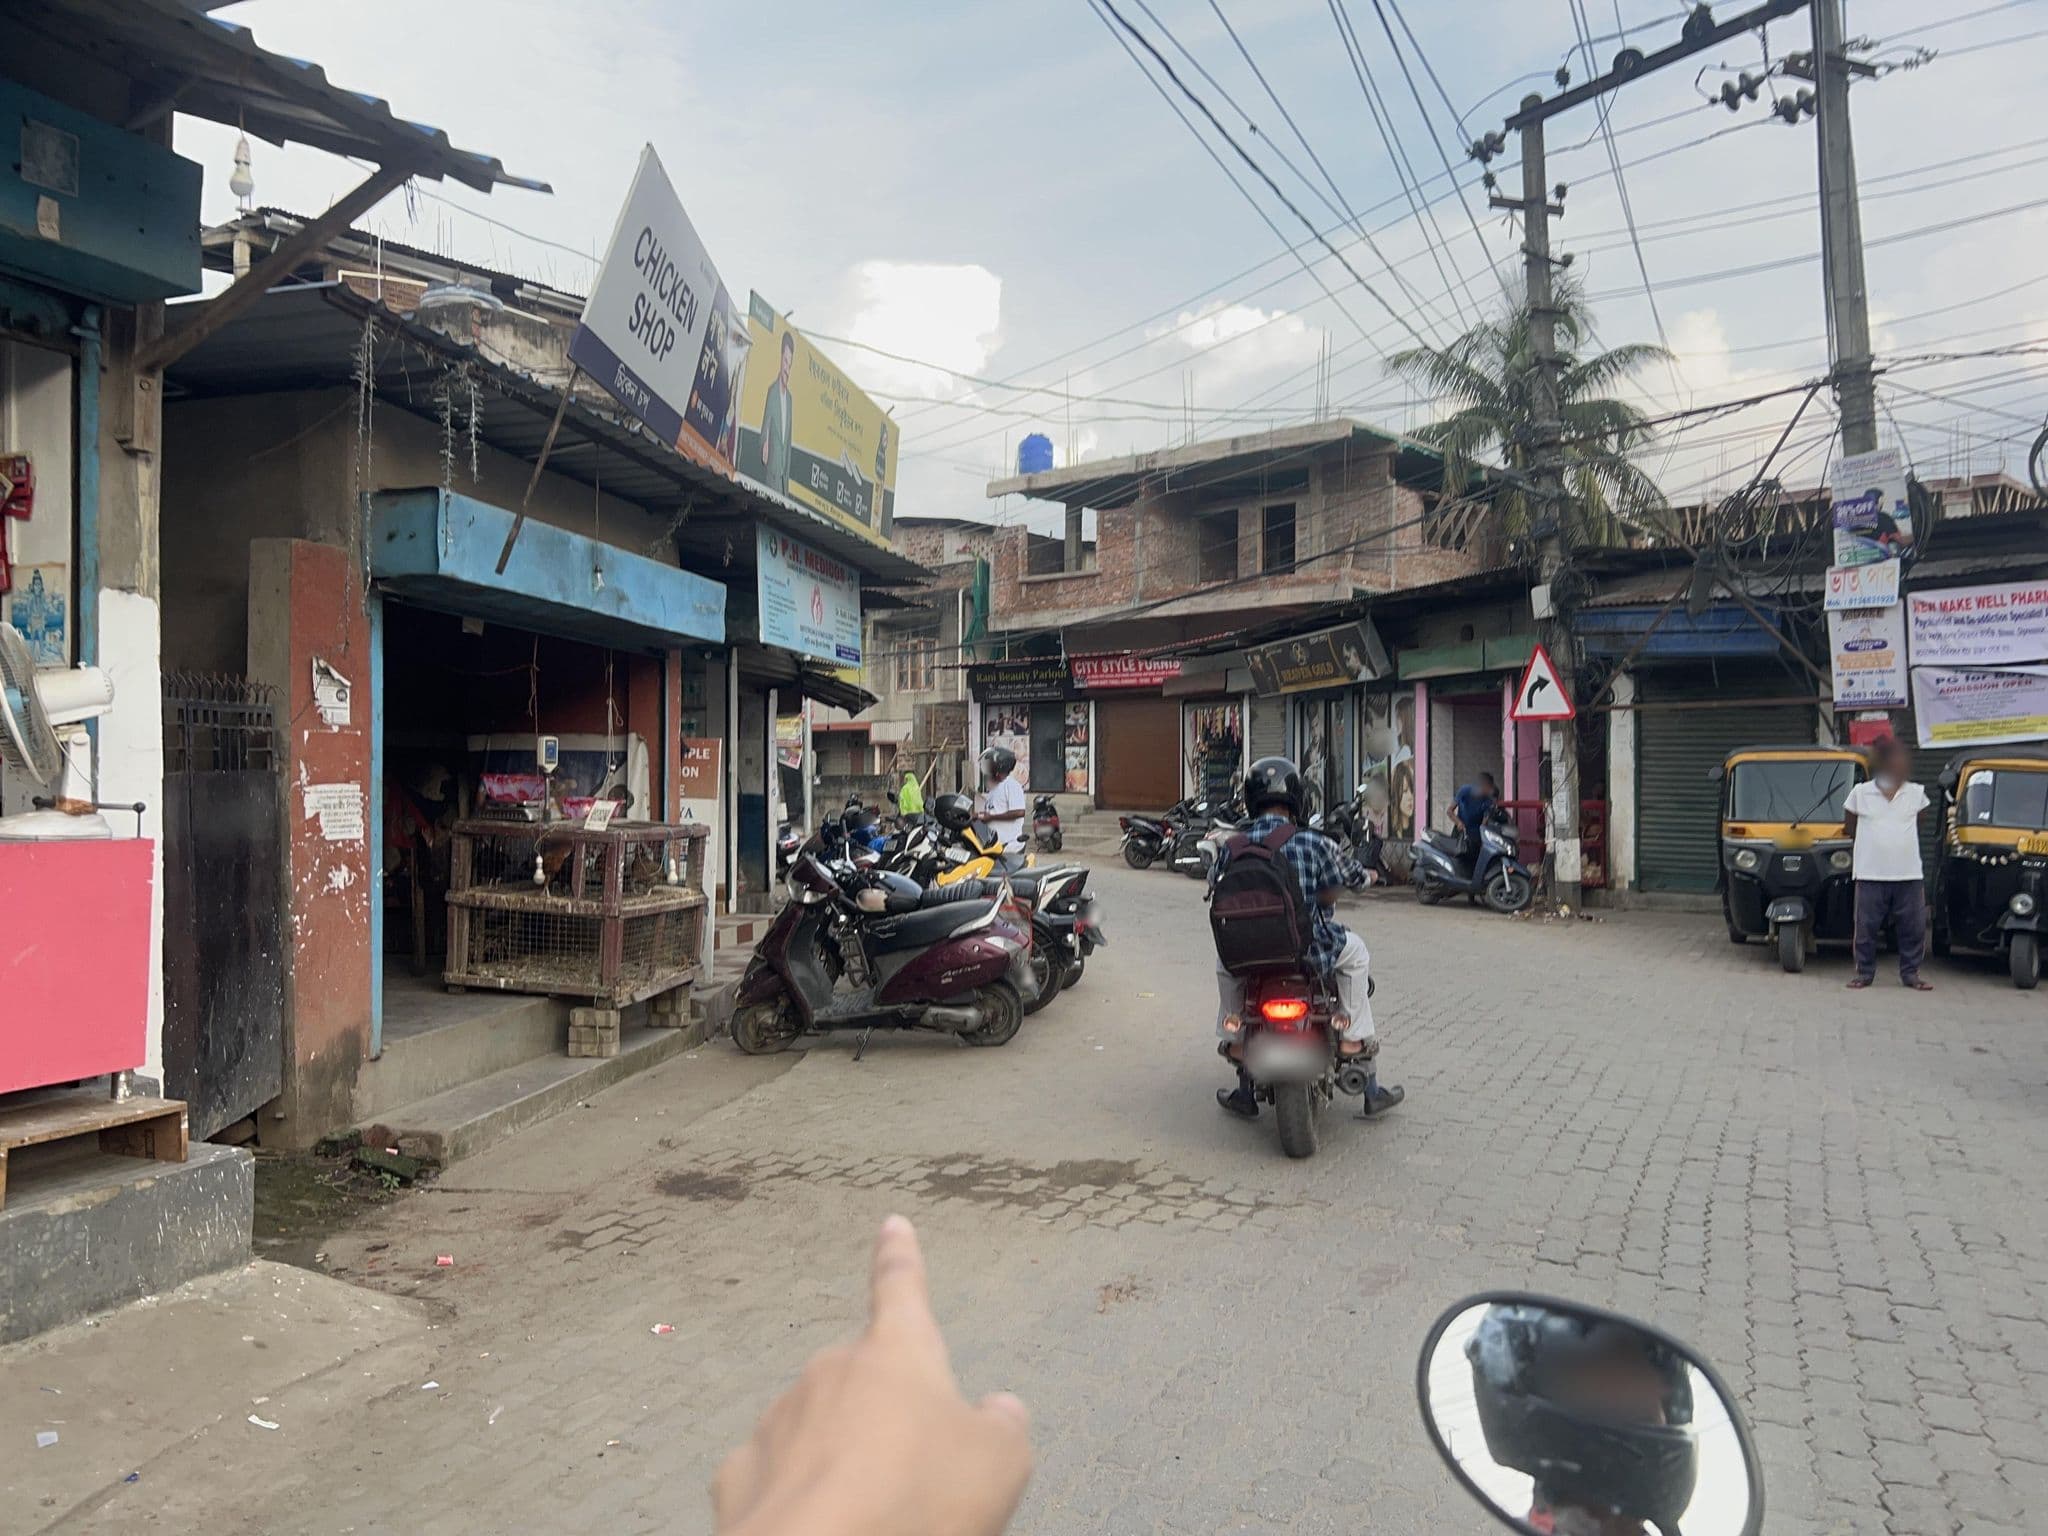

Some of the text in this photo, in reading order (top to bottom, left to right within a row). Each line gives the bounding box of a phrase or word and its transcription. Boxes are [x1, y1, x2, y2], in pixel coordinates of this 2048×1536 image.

[633, 226, 699, 334] CHICKEN
[628, 293, 675, 362] SHOP
[1939, 597, 1972, 613] MAKE
[1975, 594, 2007, 609] WELL
[999, 670, 1031, 682] Beauty
[1033, 667, 1067, 679] Parlour
[1074, 661, 1098, 675] CITY
[1101, 659, 1136, 673] STYLE
